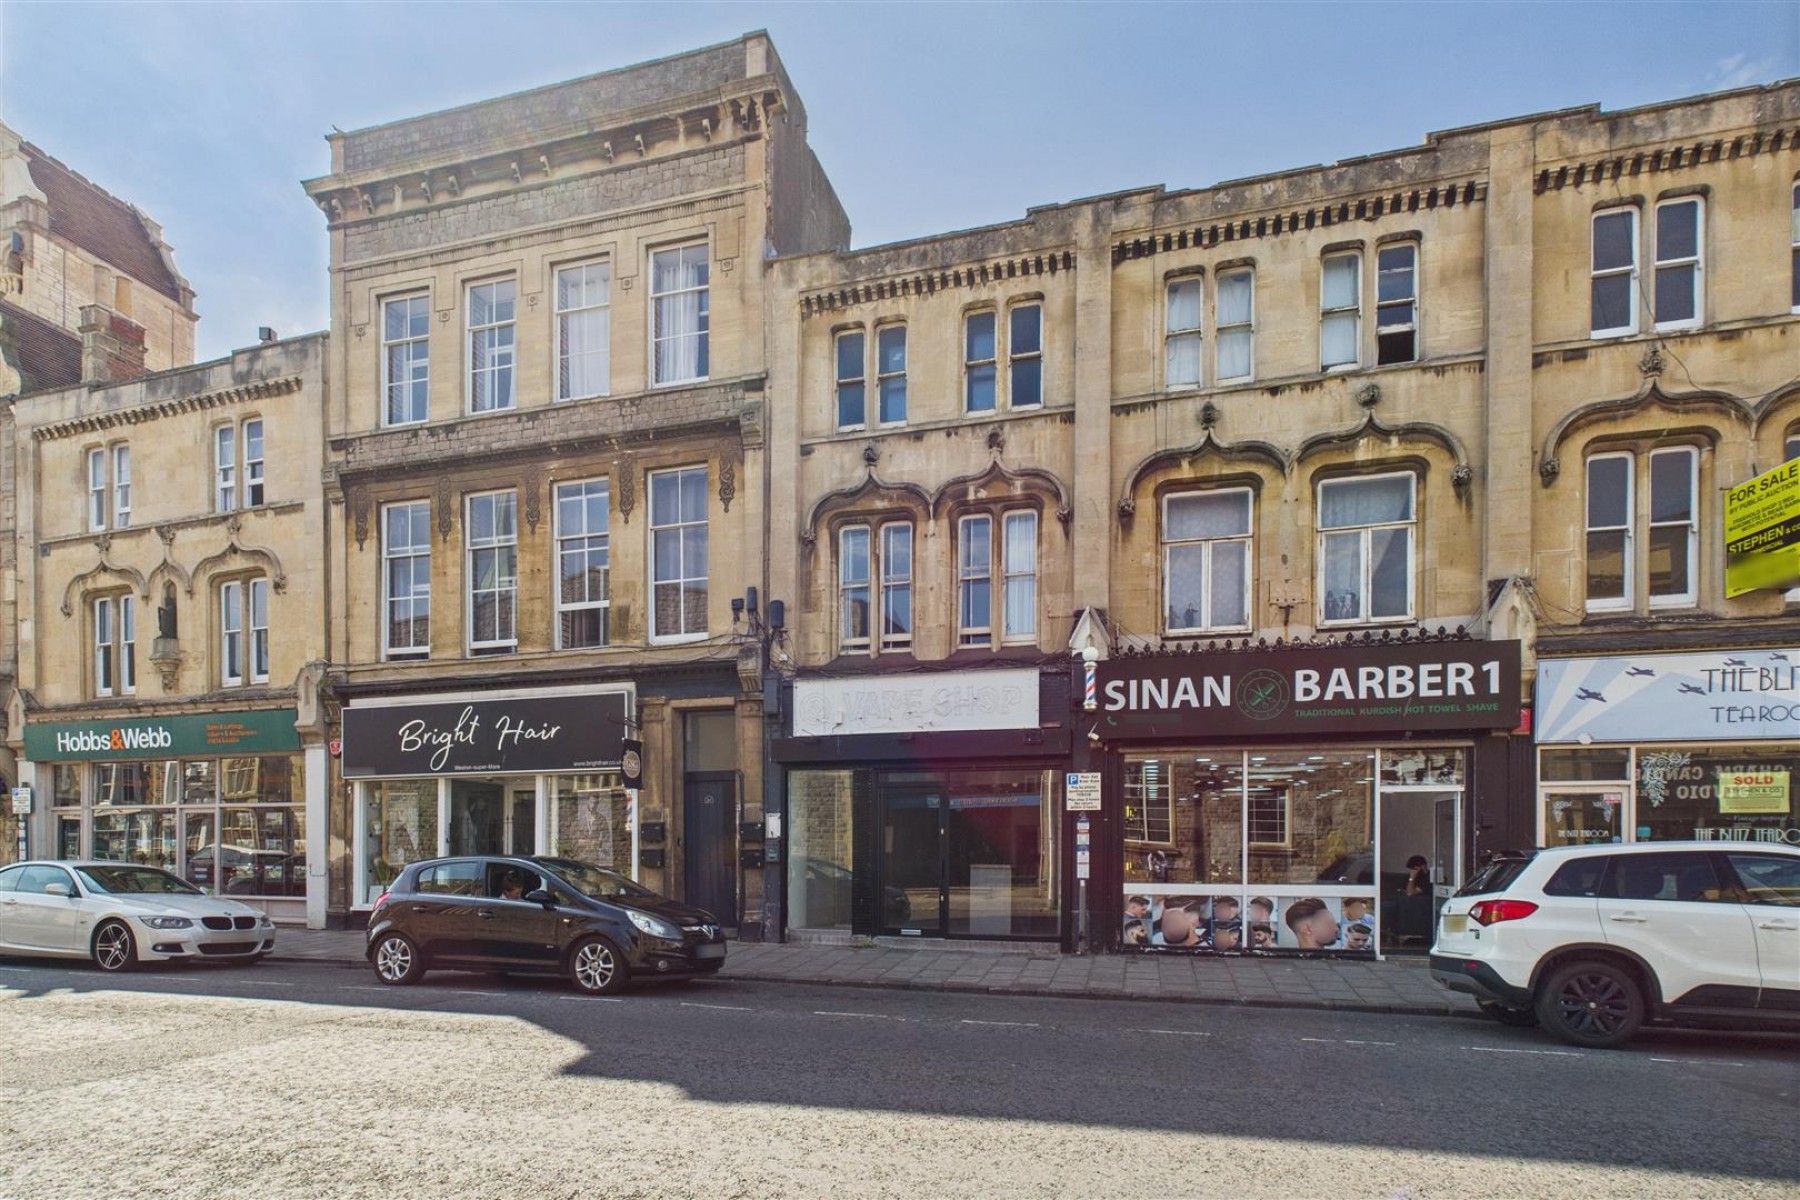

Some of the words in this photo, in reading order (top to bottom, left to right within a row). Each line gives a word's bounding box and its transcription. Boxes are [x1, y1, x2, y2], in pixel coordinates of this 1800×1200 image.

[1729, 484, 1756, 507] FOR
[1760, 464, 1798, 491] SALE
[1729, 506, 1739, 514] BY
[1739, 494, 1764, 510] PUBLIC
[1765, 479, 1799, 498] AUCTION
[1729, 525, 1784, 554] STEPHEN
[933, 685, 1022, 718] SHOP
[1105, 675, 1230, 711] SINAN
[1295, 708, 1356, 717] TRADITIONAL
[1360, 706, 1401, 715] KURDISH
[1405, 706, 1424, 714] HOT
[1429, 704, 1461, 713] TOWEL
[1466, 703, 1499, 712] SHAVE
[57, 726, 171, 752] Hobbs&Webb
[399, 705, 480, 771] Bright
[495, 715, 561, 751] Hair
[1734, 775, 1774, 785] SOLD
